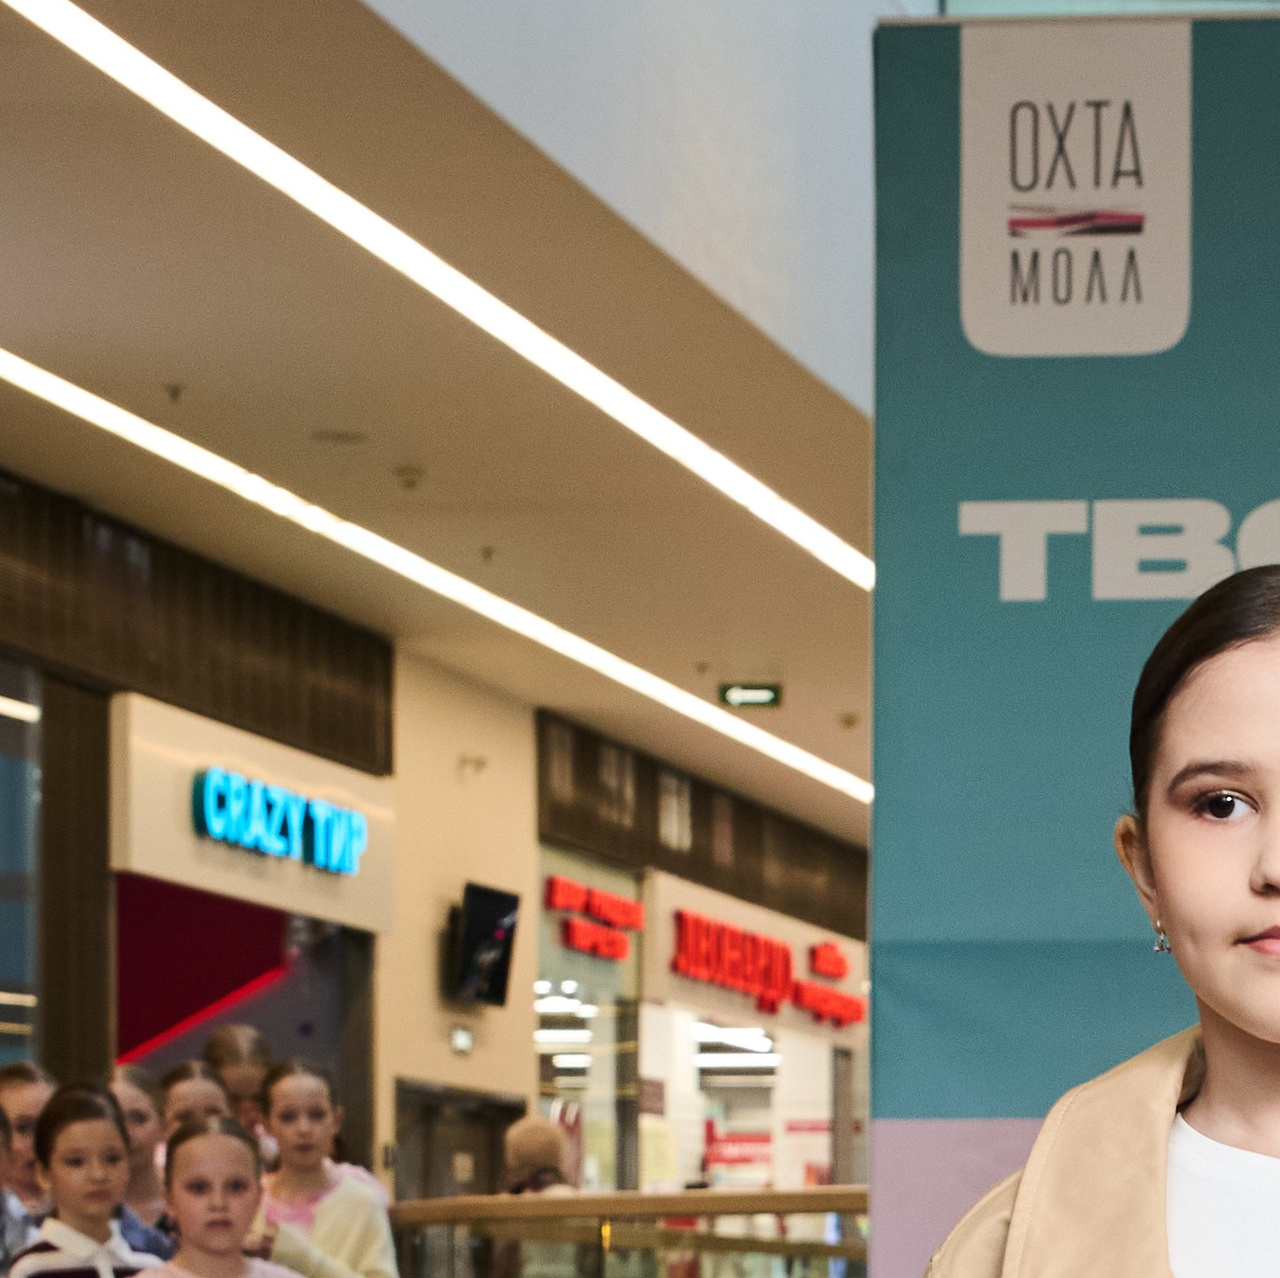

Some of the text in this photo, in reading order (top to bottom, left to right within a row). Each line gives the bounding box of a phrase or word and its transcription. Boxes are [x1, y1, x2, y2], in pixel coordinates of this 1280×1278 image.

[1007, 100, 1145, 192] ОХТА
[1008, 247, 1145, 305] МОЛЛ
[200, 766, 308, 860] CRAZY
